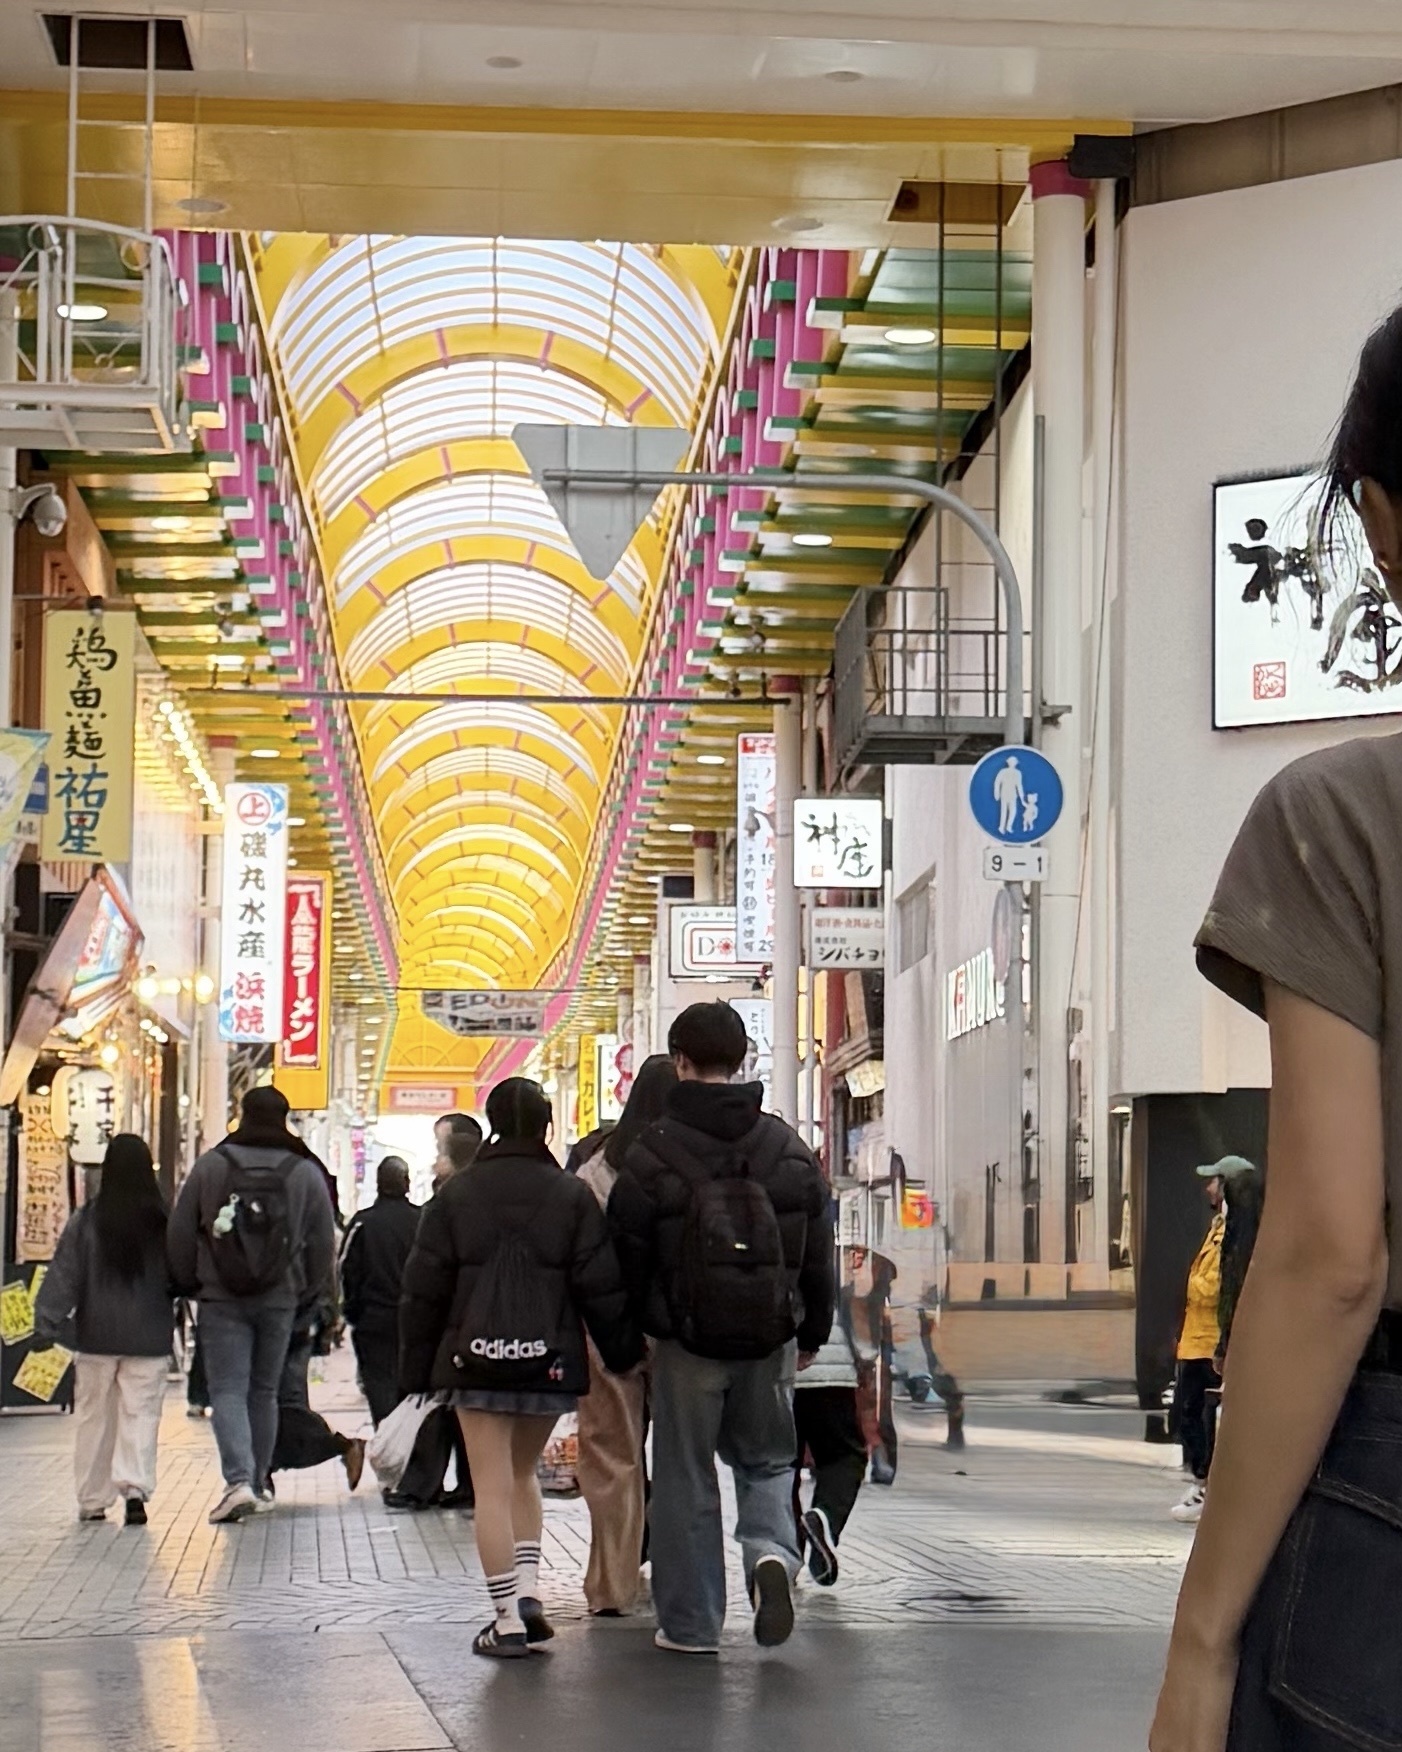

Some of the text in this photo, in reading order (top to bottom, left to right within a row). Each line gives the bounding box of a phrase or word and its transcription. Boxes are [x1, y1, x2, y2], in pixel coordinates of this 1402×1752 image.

[237, 831, 268, 959] 磯丸水産
[818, 946, 885, 962] シバチョ
[234, 971, 266, 1035] 浜焼
[469, 1337, 548, 1360] adidas
